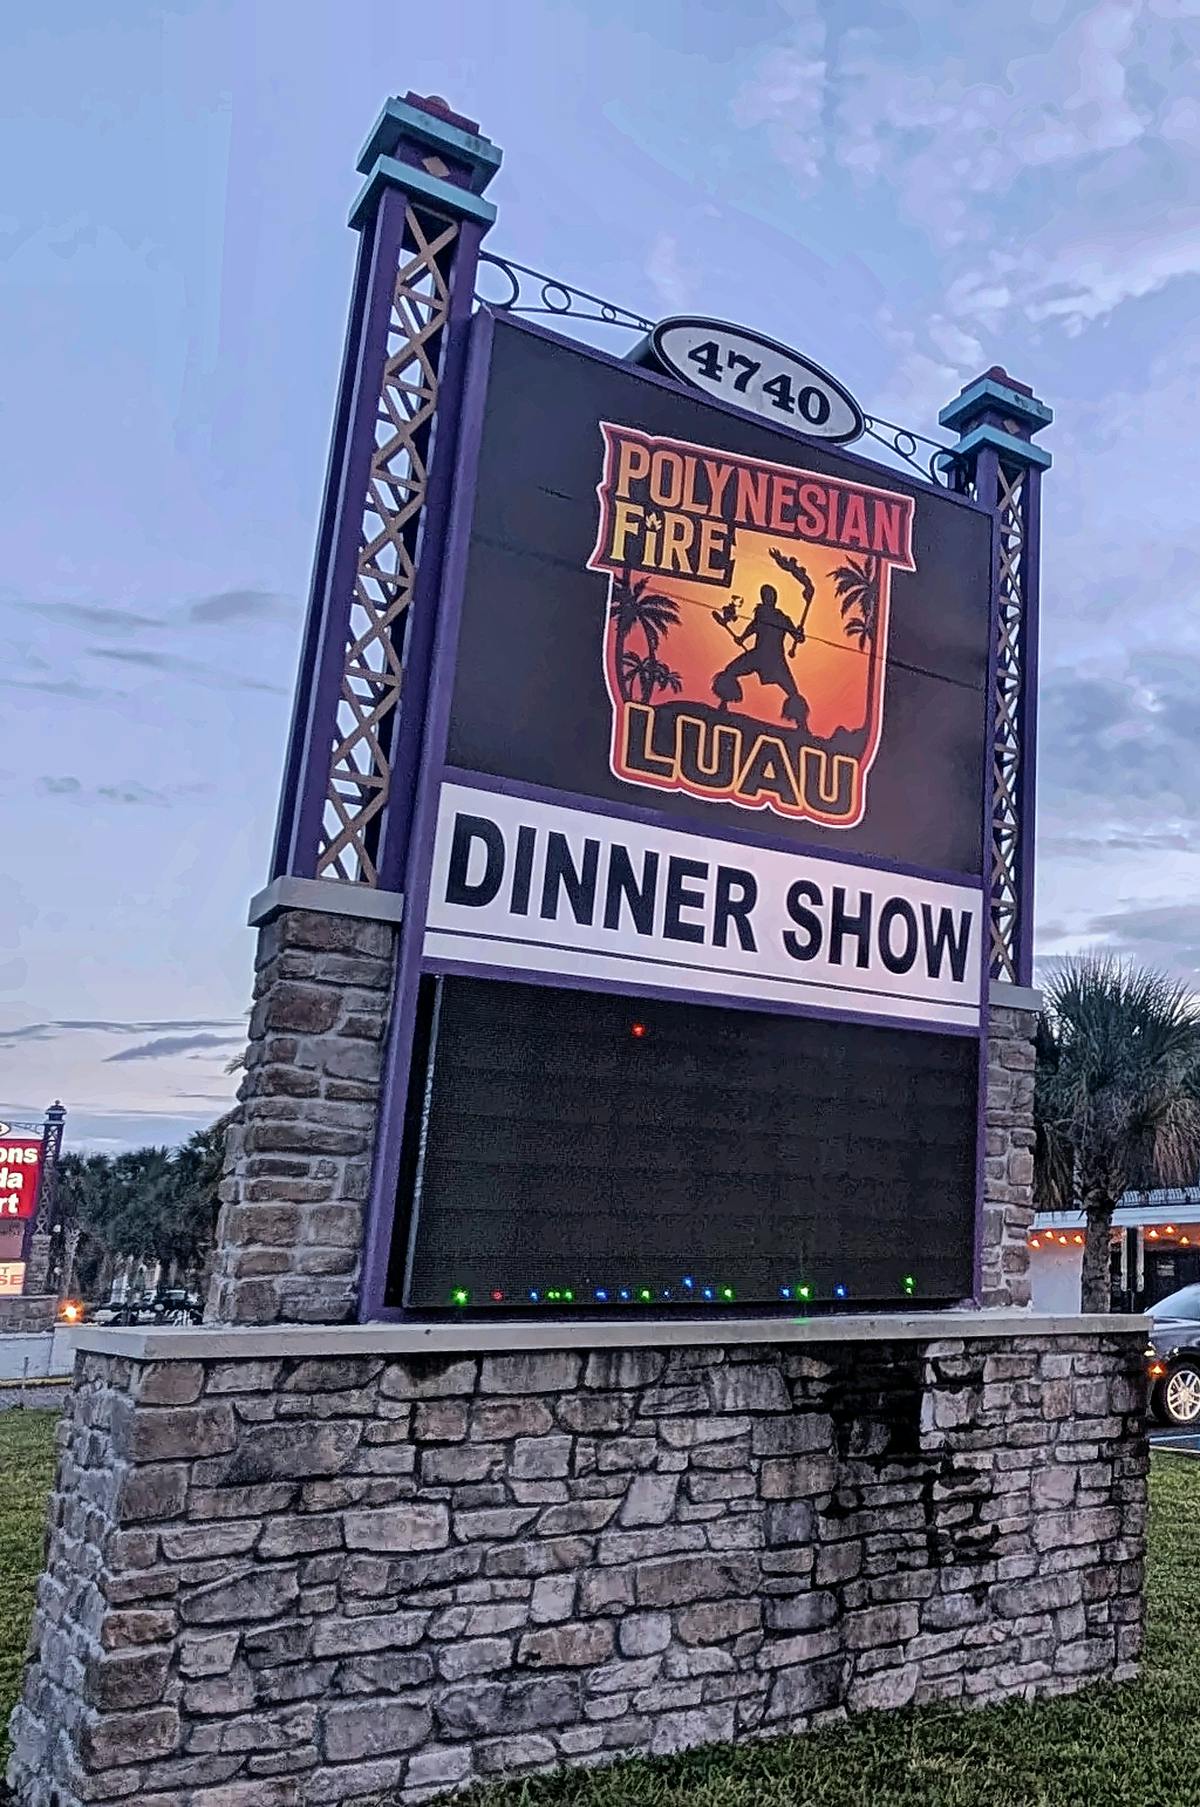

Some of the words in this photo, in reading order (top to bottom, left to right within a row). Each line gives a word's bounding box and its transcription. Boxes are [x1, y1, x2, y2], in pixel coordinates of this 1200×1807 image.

[688, 341, 831, 426] 4740
[614, 438, 901, 556] POLYNESIAN
[619, 701, 862, 817] LUAU
[444, 811, 759, 953] DINNER
[782, 879, 973, 984] SHOW
